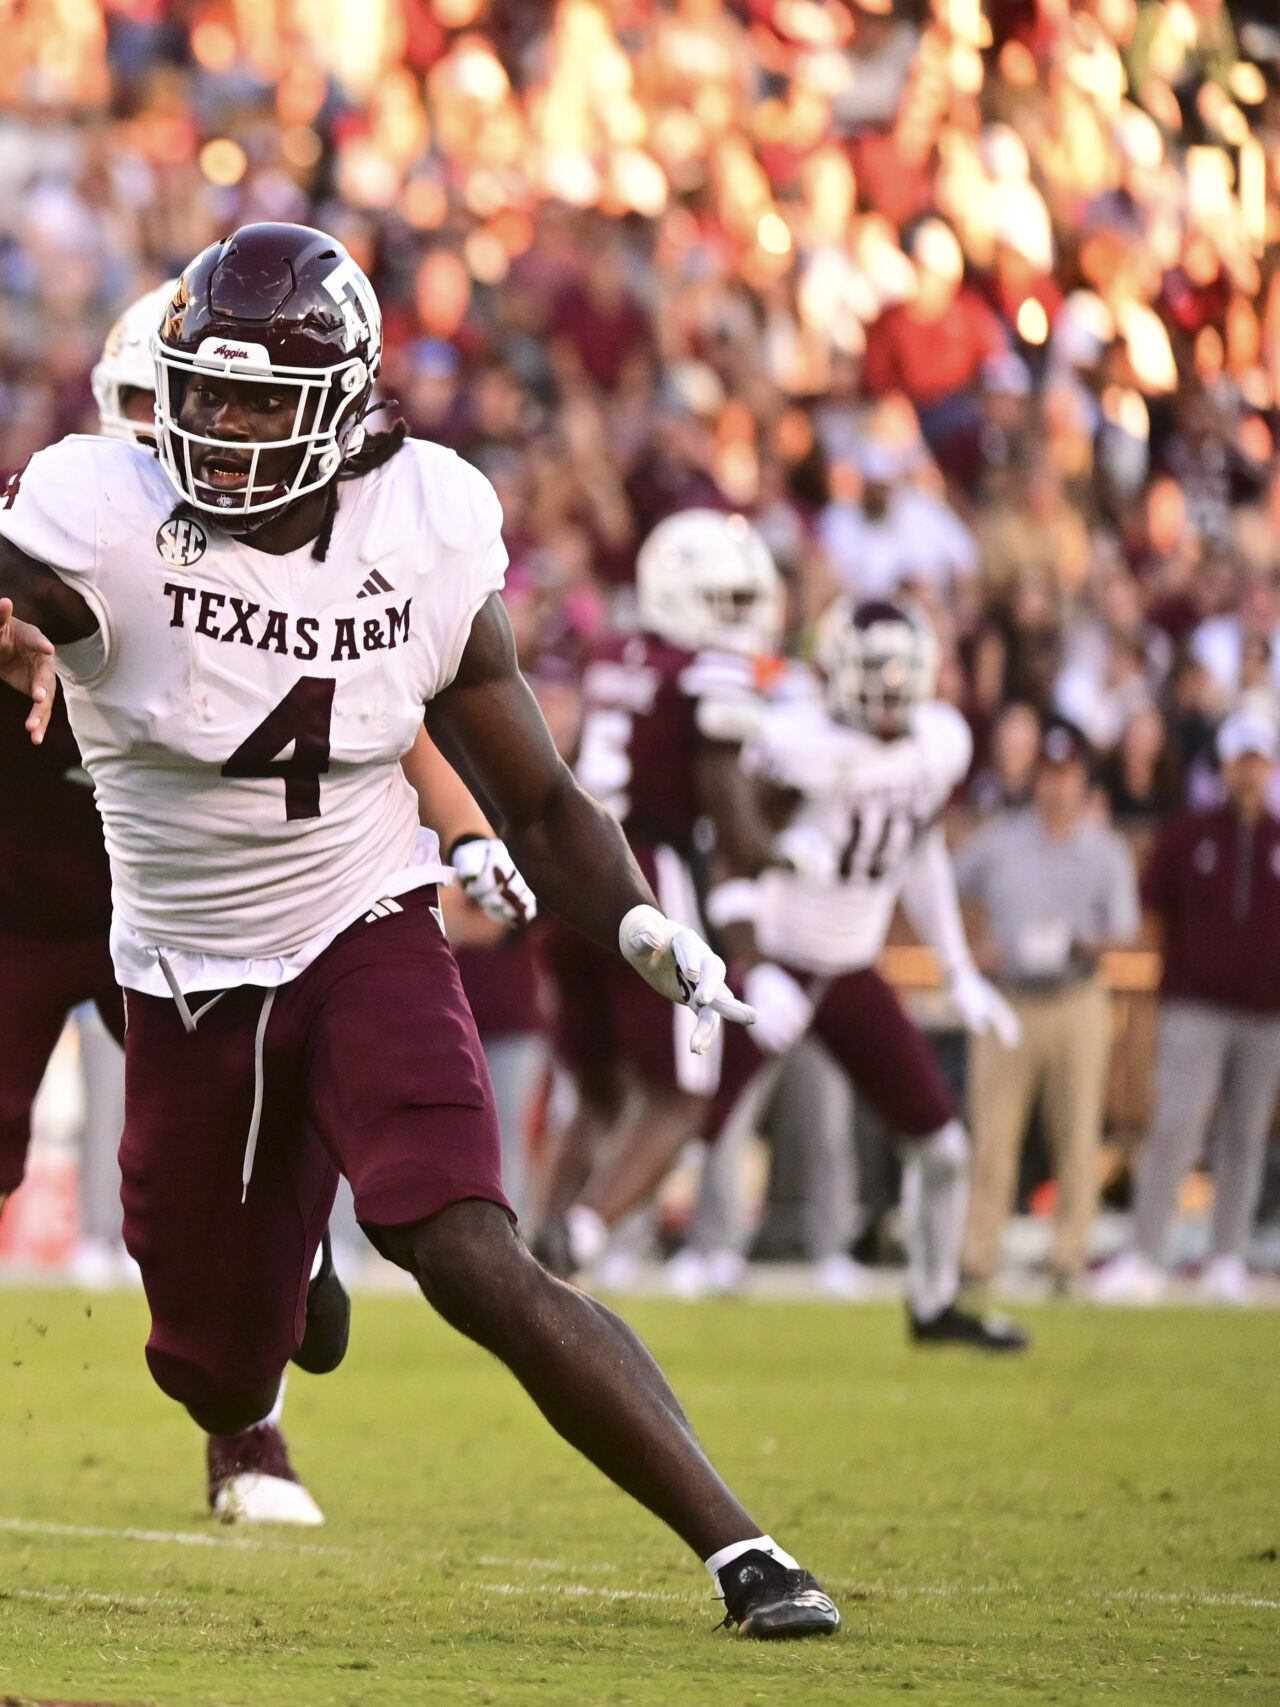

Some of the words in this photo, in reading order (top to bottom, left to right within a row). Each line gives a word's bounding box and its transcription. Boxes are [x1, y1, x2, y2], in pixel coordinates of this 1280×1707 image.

[214, 345, 248, 359] Aggies
[159, 518, 205, 566] SEC
[163, 582, 320, 661] TEXAS
[330, 597, 413, 662] A&M
[221, 676, 336, 821] 4
